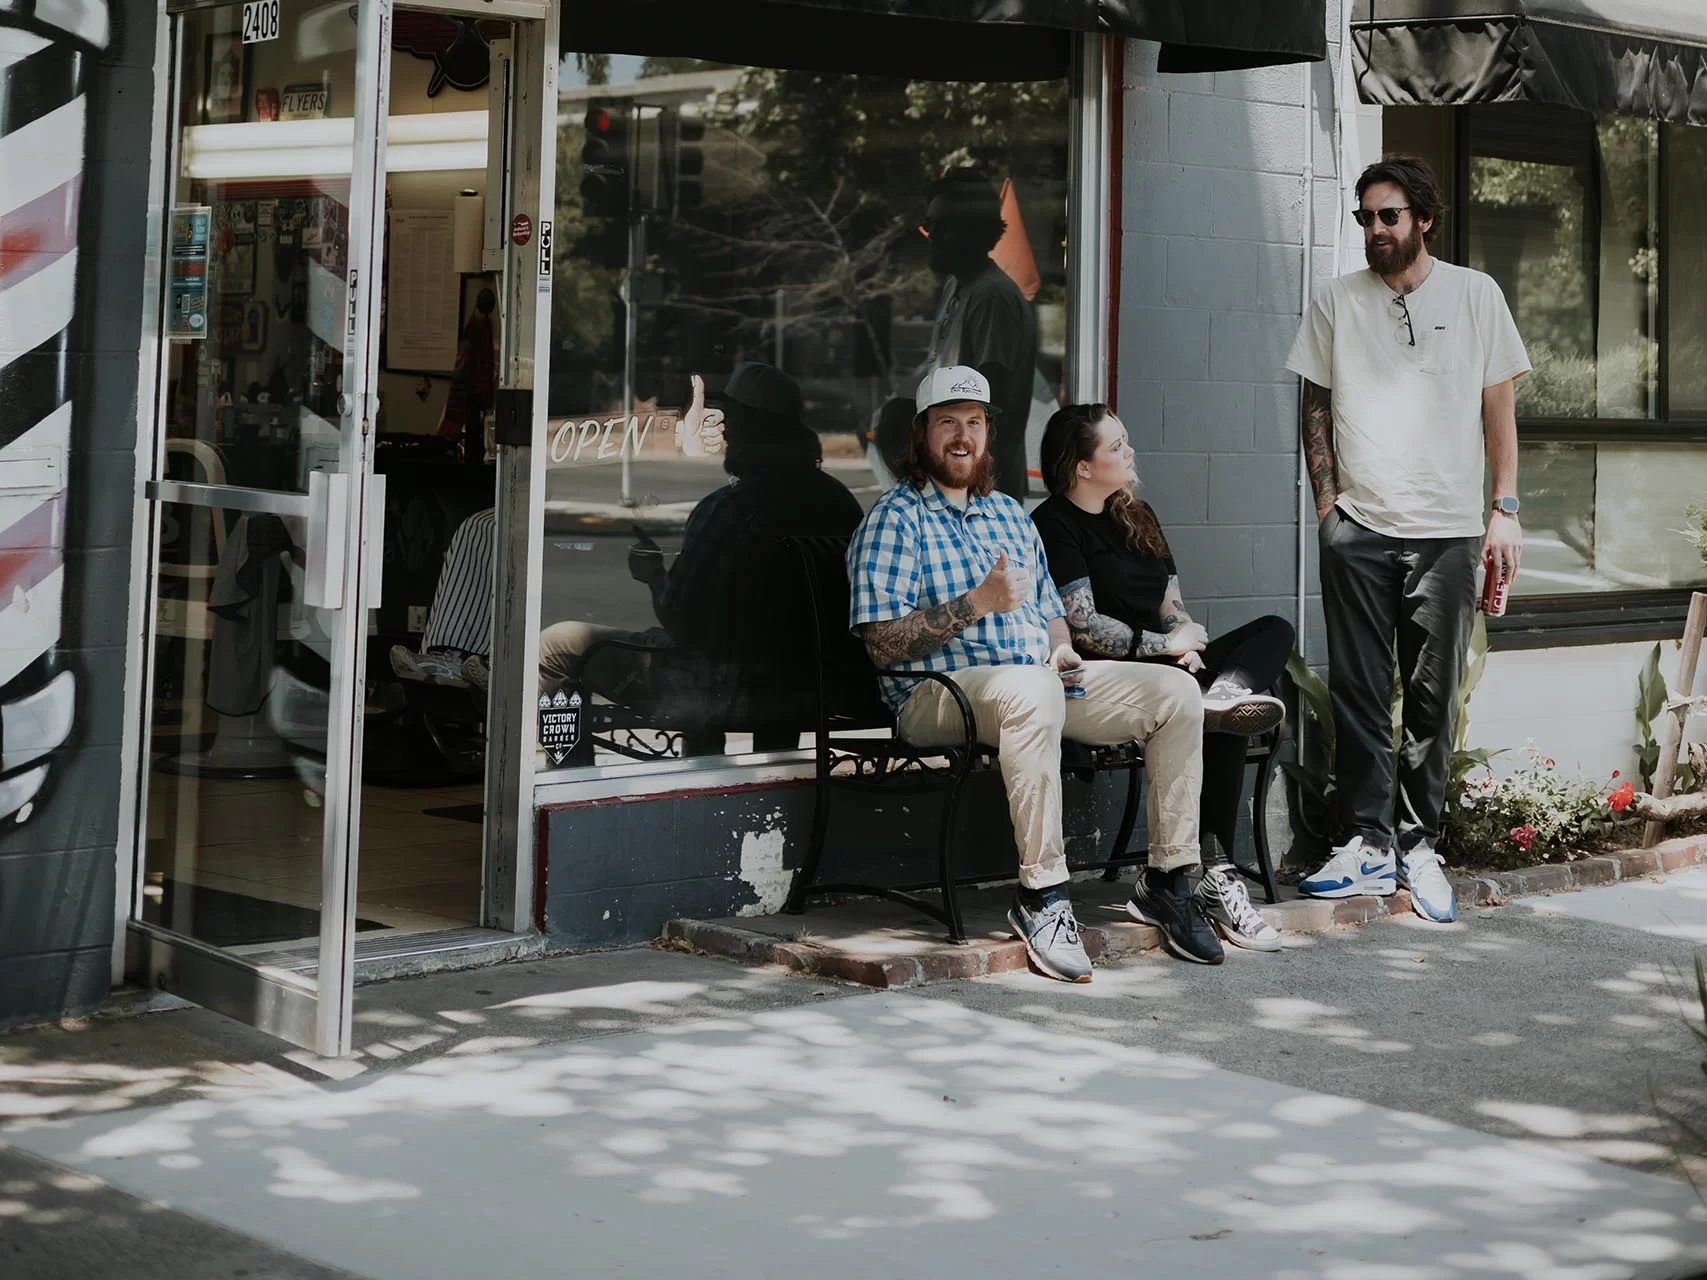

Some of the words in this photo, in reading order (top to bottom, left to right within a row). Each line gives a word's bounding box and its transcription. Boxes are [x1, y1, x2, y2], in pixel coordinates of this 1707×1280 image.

[243, 0, 278, 42] 2408
[281, 93, 326, 113] FLYERS
[541, 222, 551, 274] PULL
[348, 271, 357, 334] PULL
[551, 415, 654, 463] OPEN
[542, 713, 577, 724] VICTORY
[543, 724, 575, 735] CROWN
